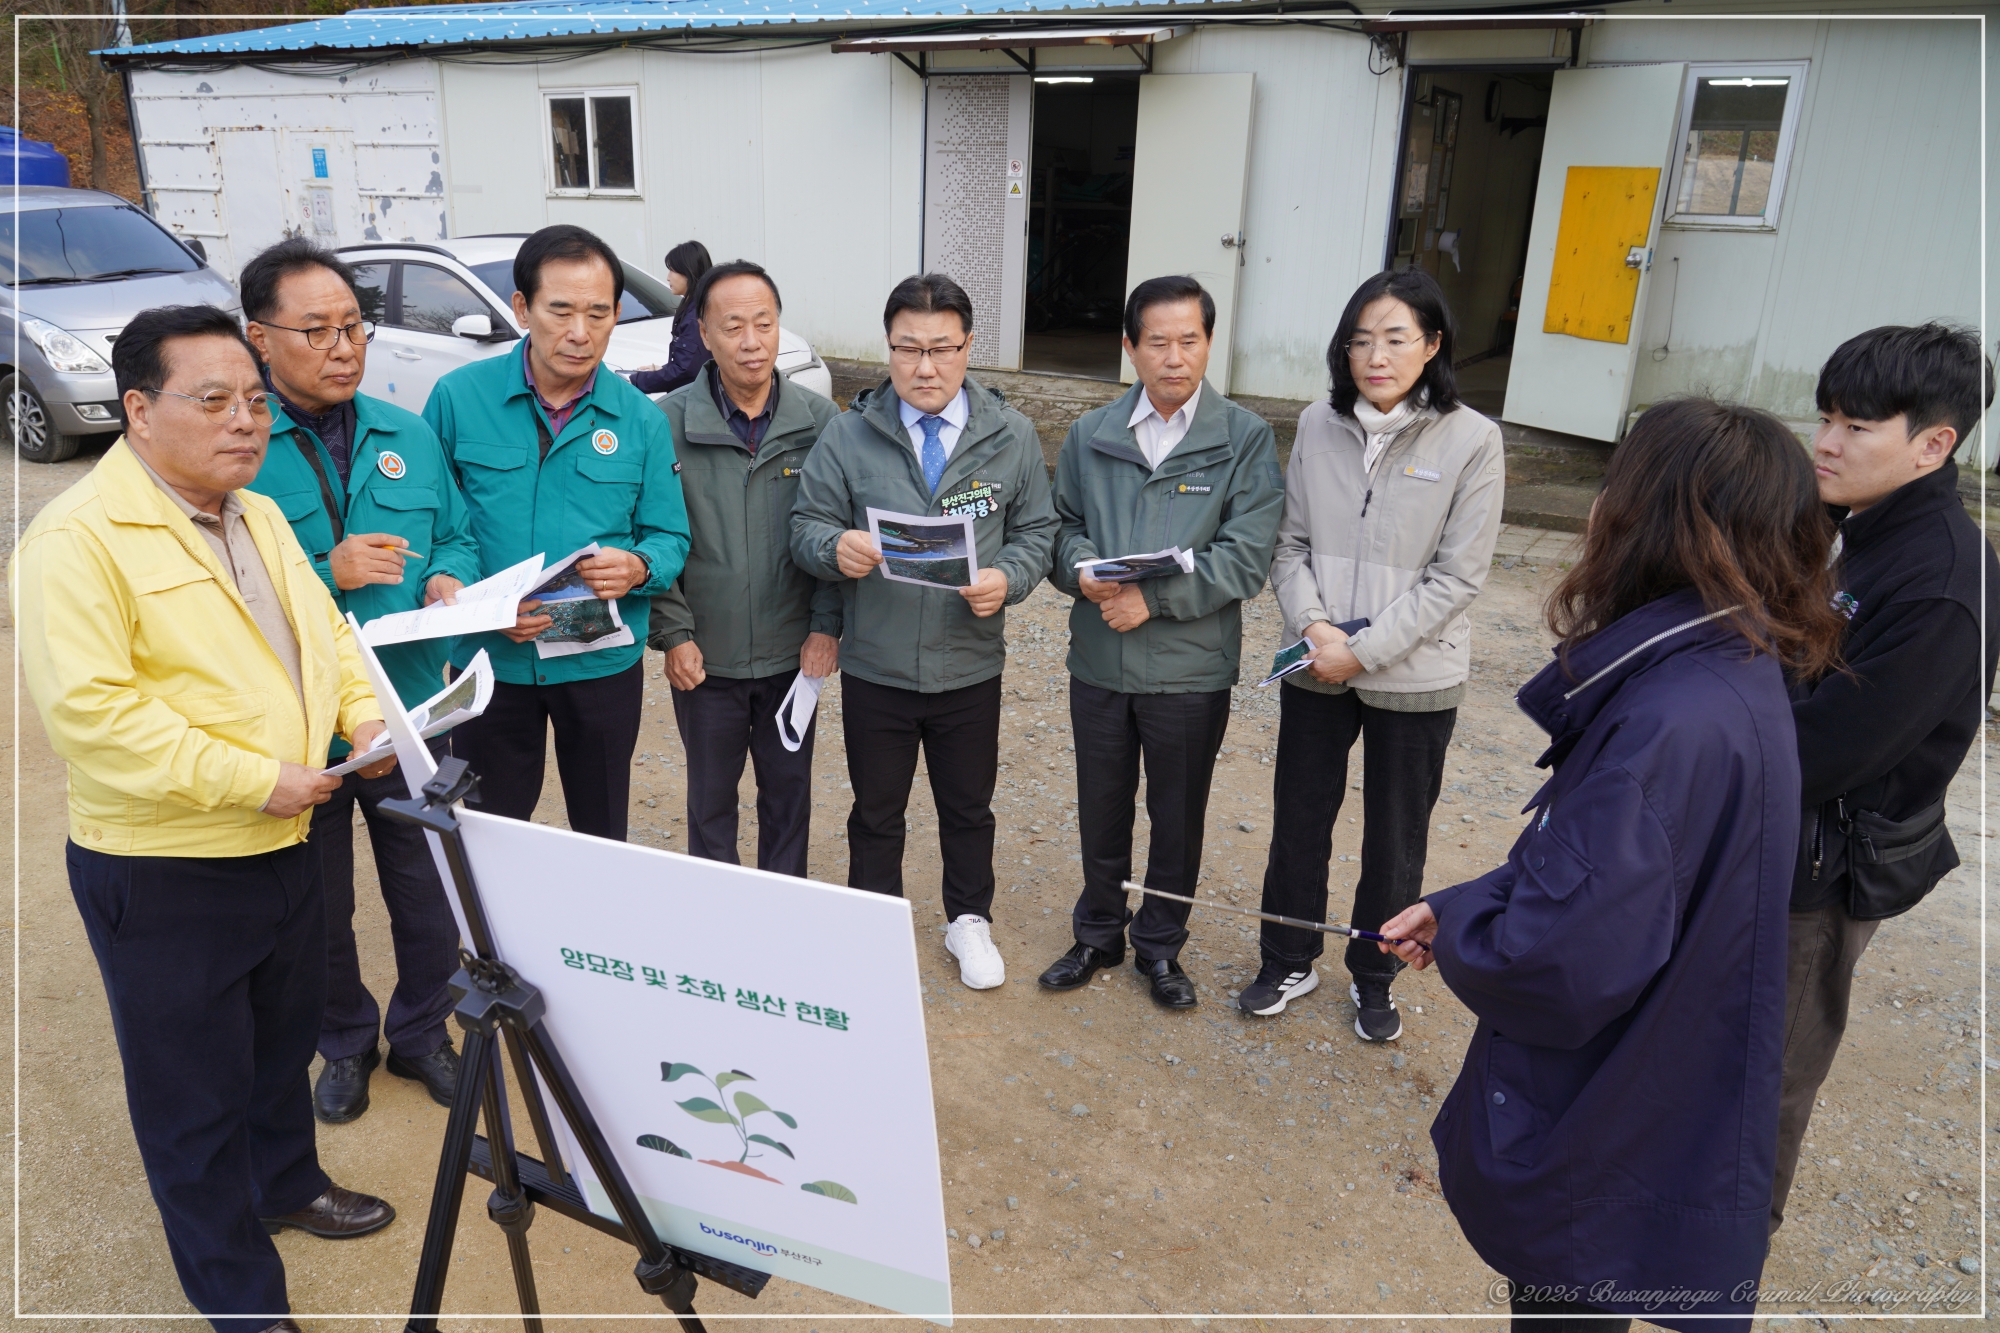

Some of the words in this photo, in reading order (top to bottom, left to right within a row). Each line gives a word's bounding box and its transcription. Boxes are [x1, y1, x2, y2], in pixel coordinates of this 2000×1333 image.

[941, 486, 992, 508] 부산진구의원
[560, 947, 635, 982] 양묘장
[641, 965, 669, 990] 및
[675, 974, 727, 1003] 초화
[734, 987, 787, 1018] 생산
[795, 1000, 850, 1032] 현황
[699, 1222, 778, 1254] busanjin
[780, 1248, 823, 1266] 부산진구
